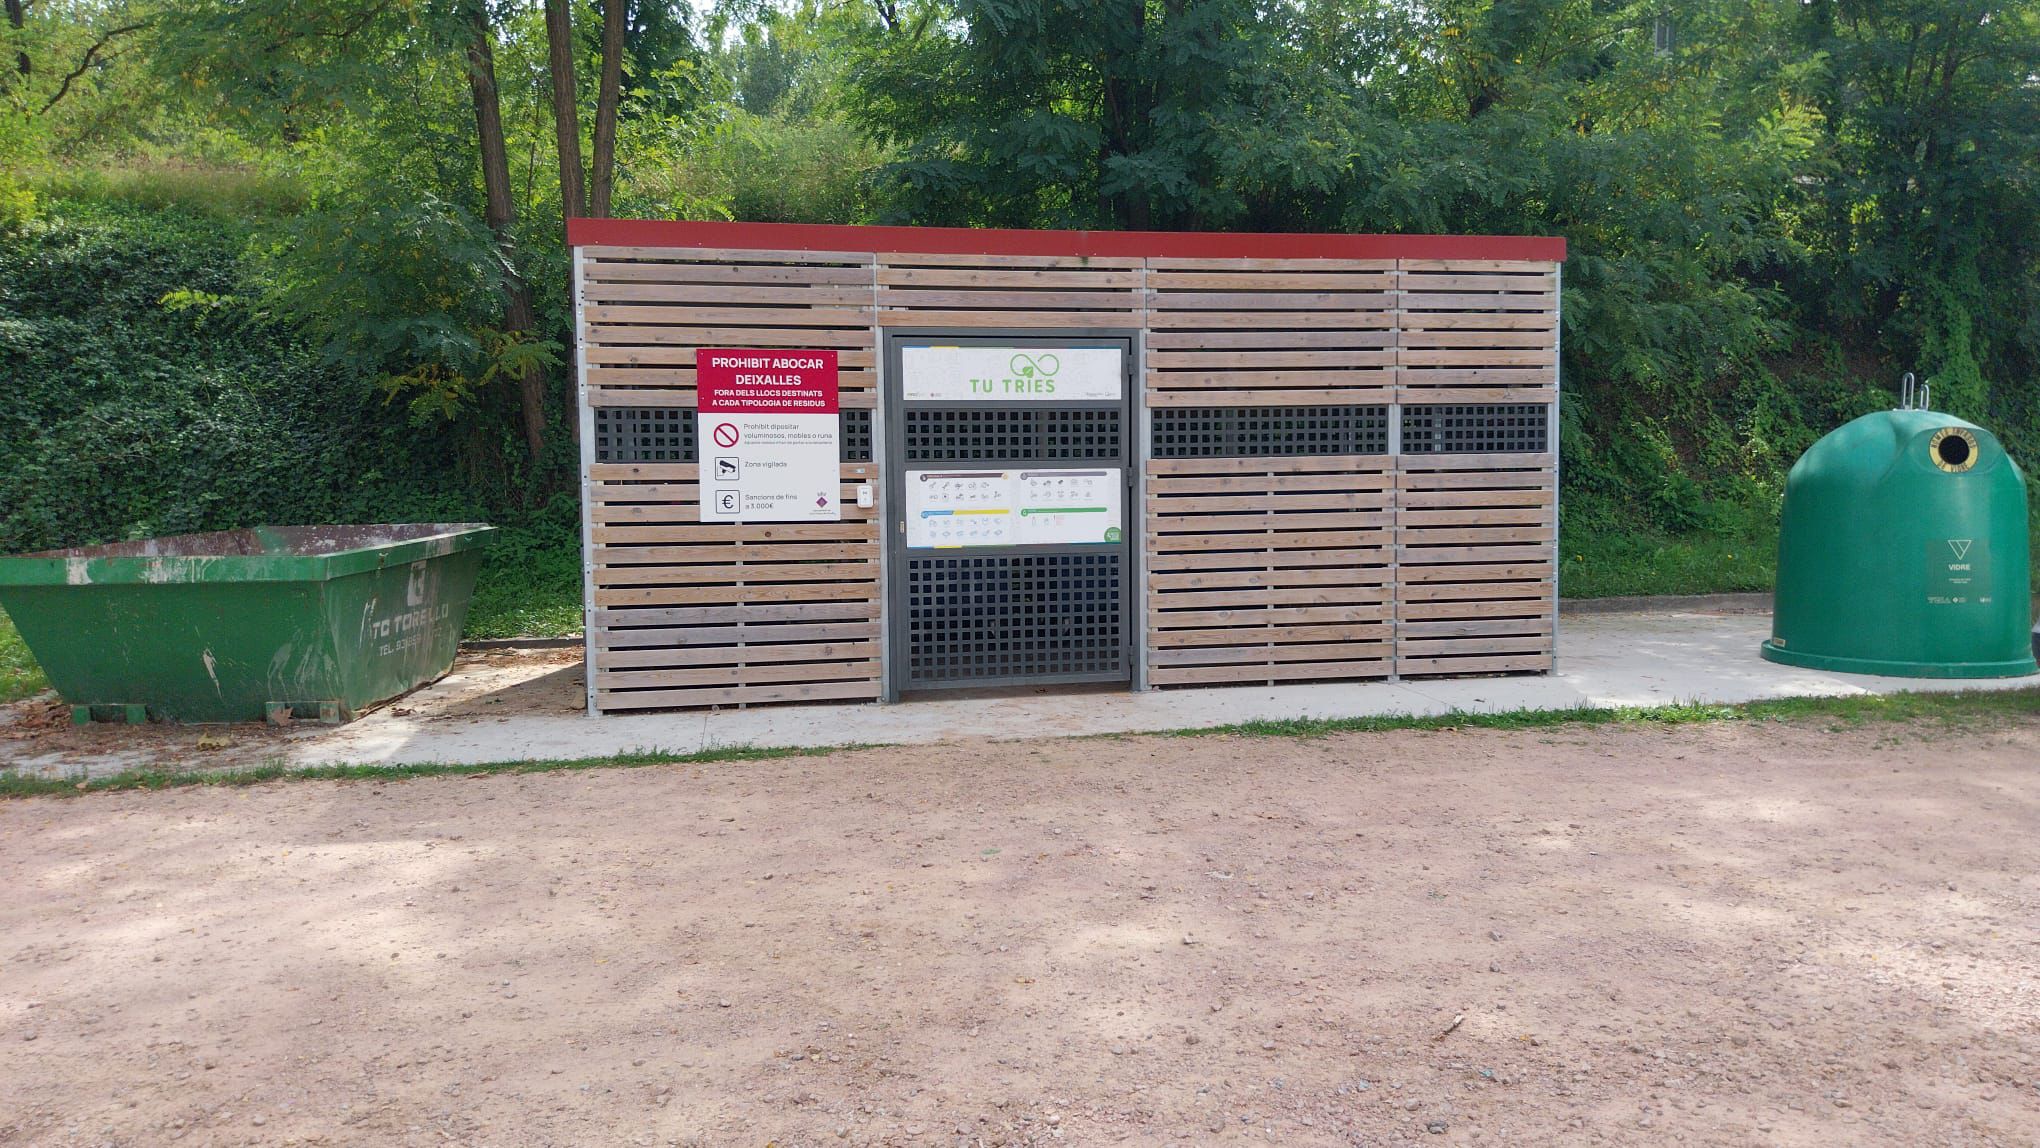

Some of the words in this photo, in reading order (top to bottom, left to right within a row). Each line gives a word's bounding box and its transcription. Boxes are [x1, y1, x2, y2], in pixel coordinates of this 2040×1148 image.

[712, 357, 770, 369] PROHIBIT
[772, 358, 824, 369] ABOCAR
[735, 374, 802, 386] DEIXALLES
[970, 379, 993, 393] TU
[1002, 379, 1055, 393] TRIES
[714, 389, 735, 397] FORA
[736, 389, 755, 397] DELS
[756, 389, 781, 397] LLOCS
[712, 399, 718, 407] A
[719, 399, 740, 407] CADA
[741, 399, 781, 407] TIPOLOGIA
[770, 423, 800, 431] dipositar
[744, 432, 787, 440] voluminosos,
[762, 460, 788, 469] vigilada
[1948, 563, 1971, 571] VIDRE
